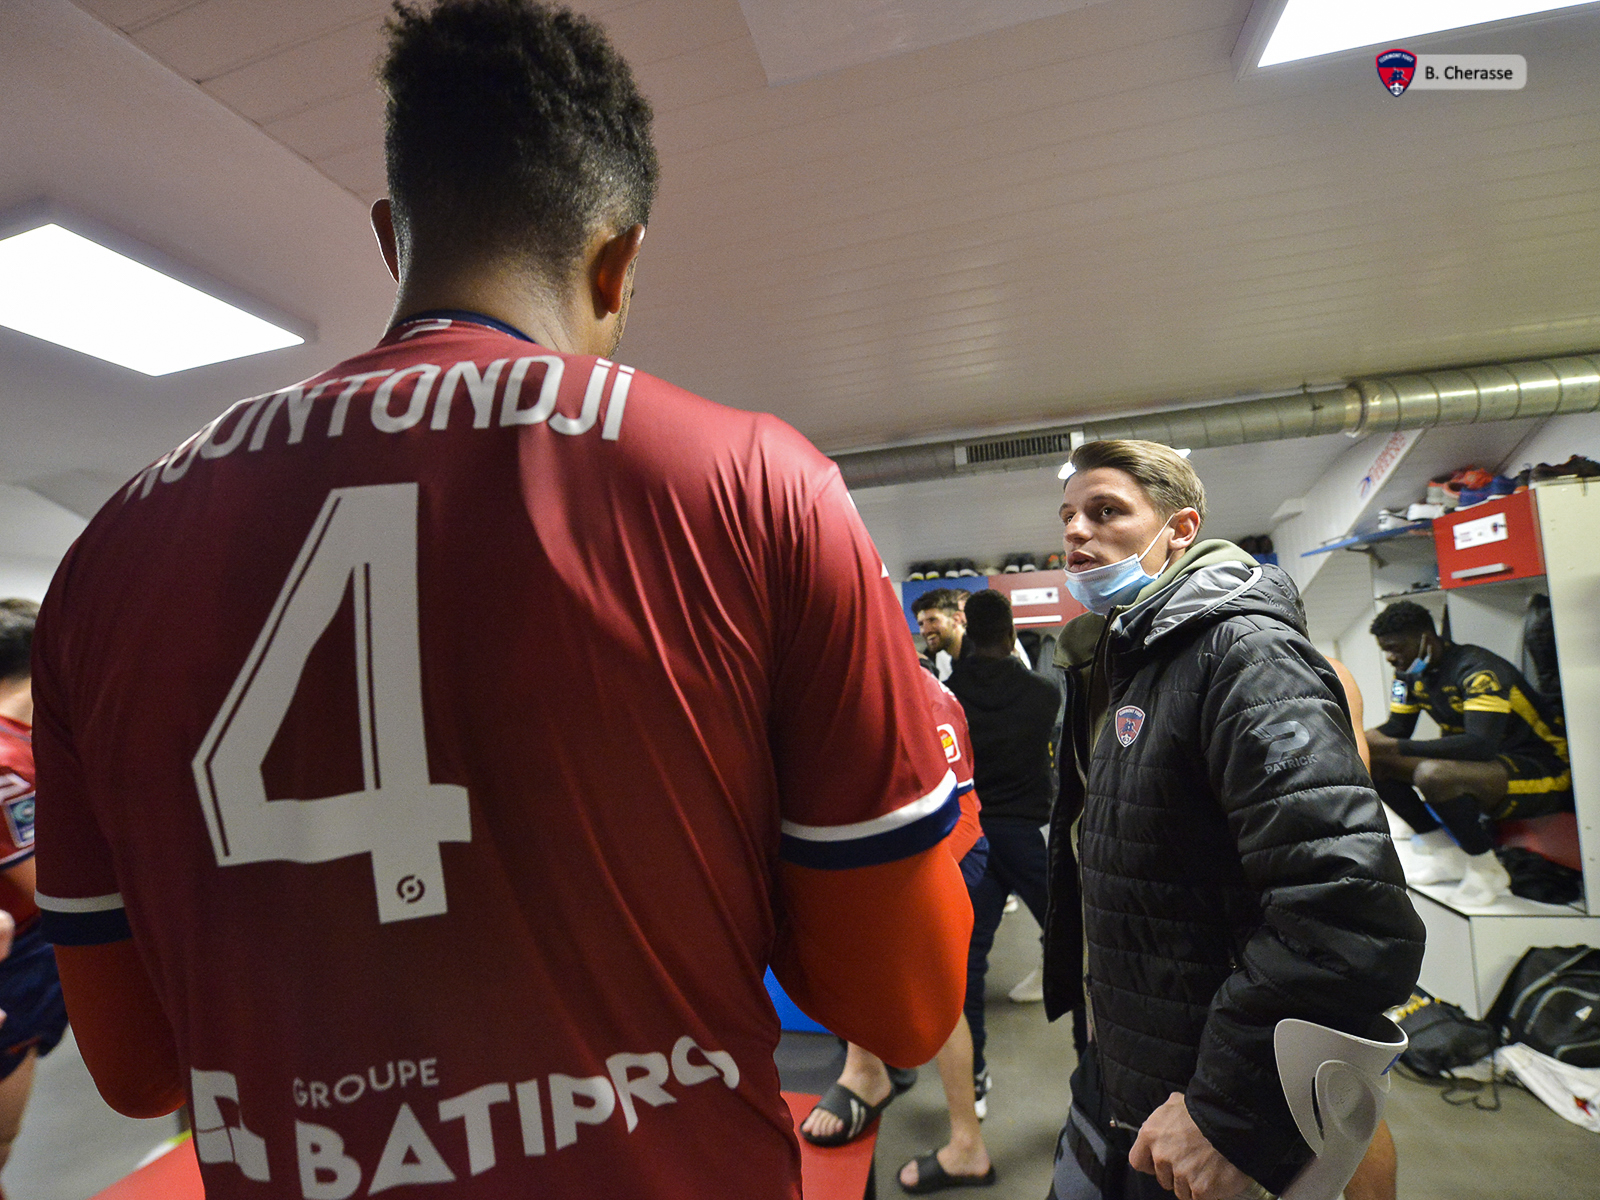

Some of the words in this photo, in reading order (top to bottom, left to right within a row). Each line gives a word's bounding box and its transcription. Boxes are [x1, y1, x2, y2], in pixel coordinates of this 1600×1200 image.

[191, 482, 473, 924] 4
[1264, 753, 1318, 775] PATRICK
[293, 1057, 440, 1108] GROUPE
[294, 1034, 741, 1200] BATIPRO
